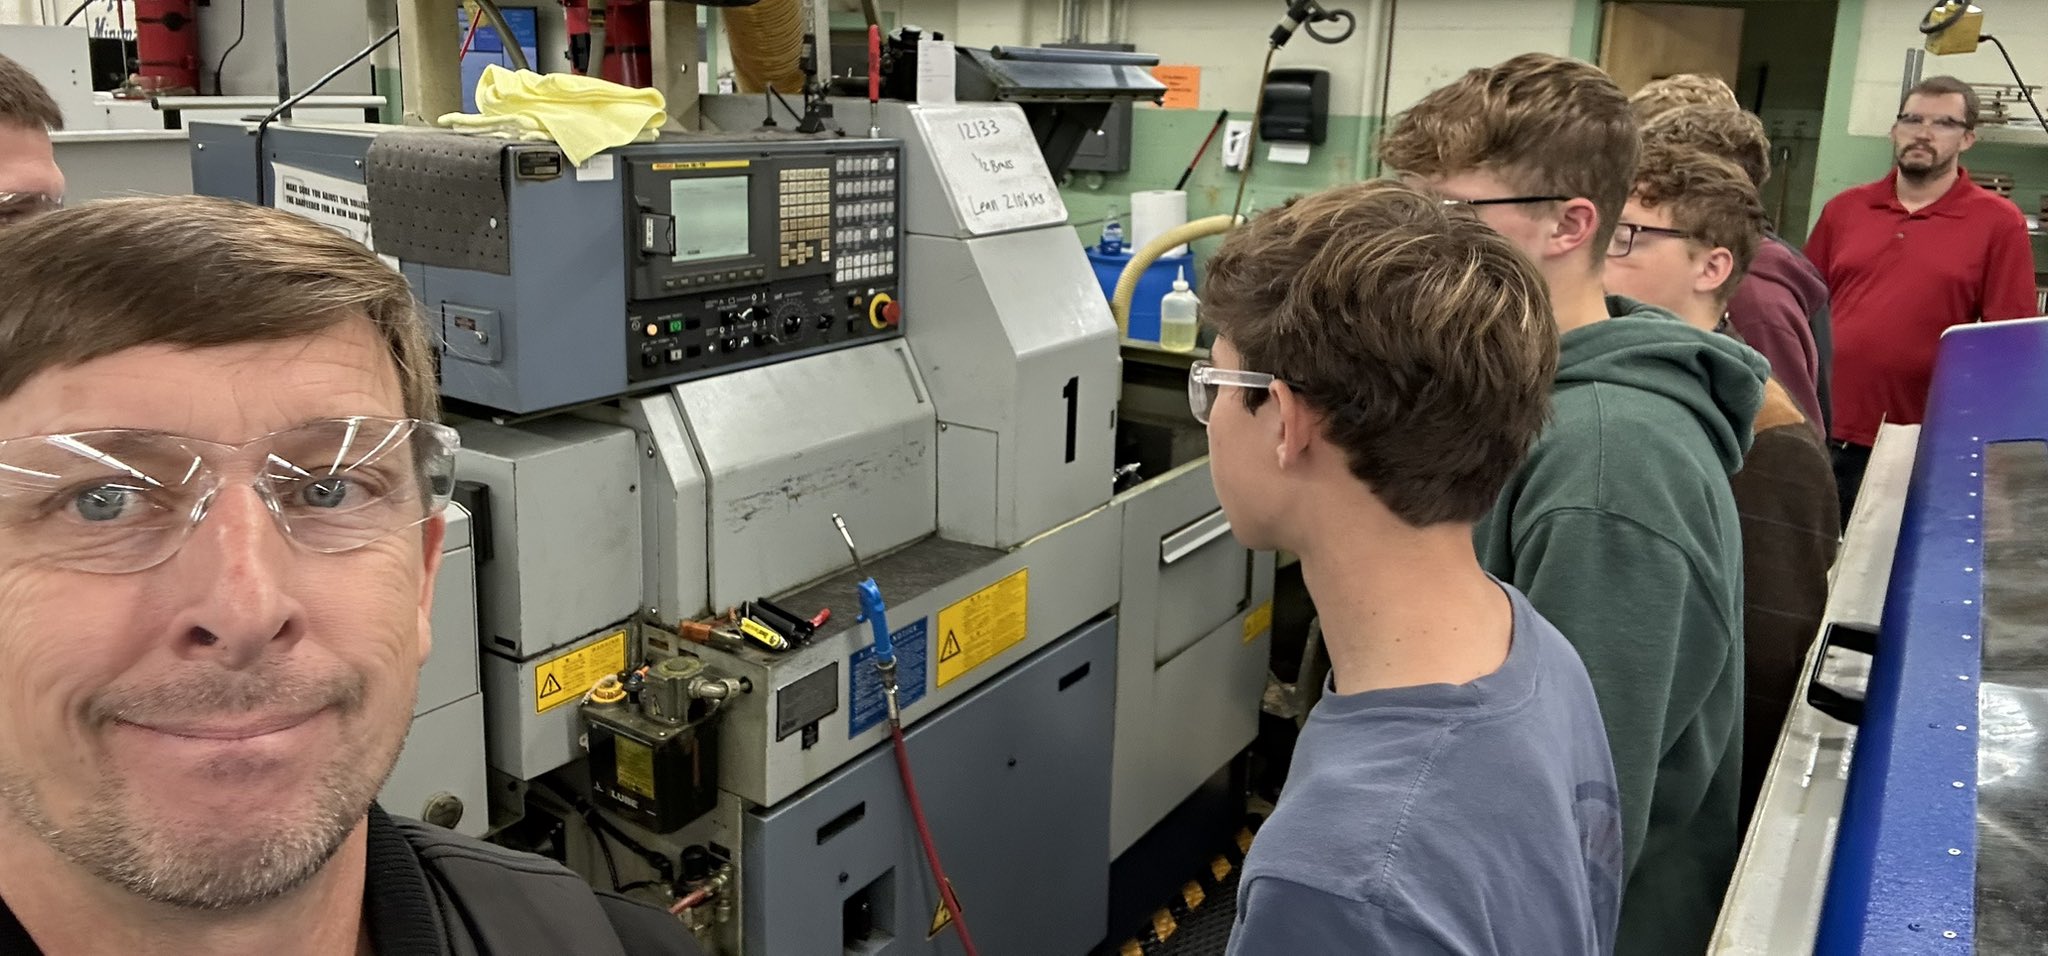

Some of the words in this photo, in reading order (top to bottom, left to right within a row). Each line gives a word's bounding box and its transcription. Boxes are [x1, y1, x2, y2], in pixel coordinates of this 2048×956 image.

[957, 119, 1001, 141] 12133
[286, 182, 297, 192] MAKE
[299, 184, 310, 196] SURE
[312, 189, 320, 198] YOU
[322, 191, 338, 203] ADJUST
[340, 195, 348, 206] THE
[286, 196, 294, 204] THE
[296, 198, 320, 210] BARFEEDER
[321, 204, 330, 213] FOR
[331, 206, 336, 214] A
[336, 208, 346, 218] NEW
[348, 210, 358, 220] BAR
[1063, 376, 1079, 464] 1
